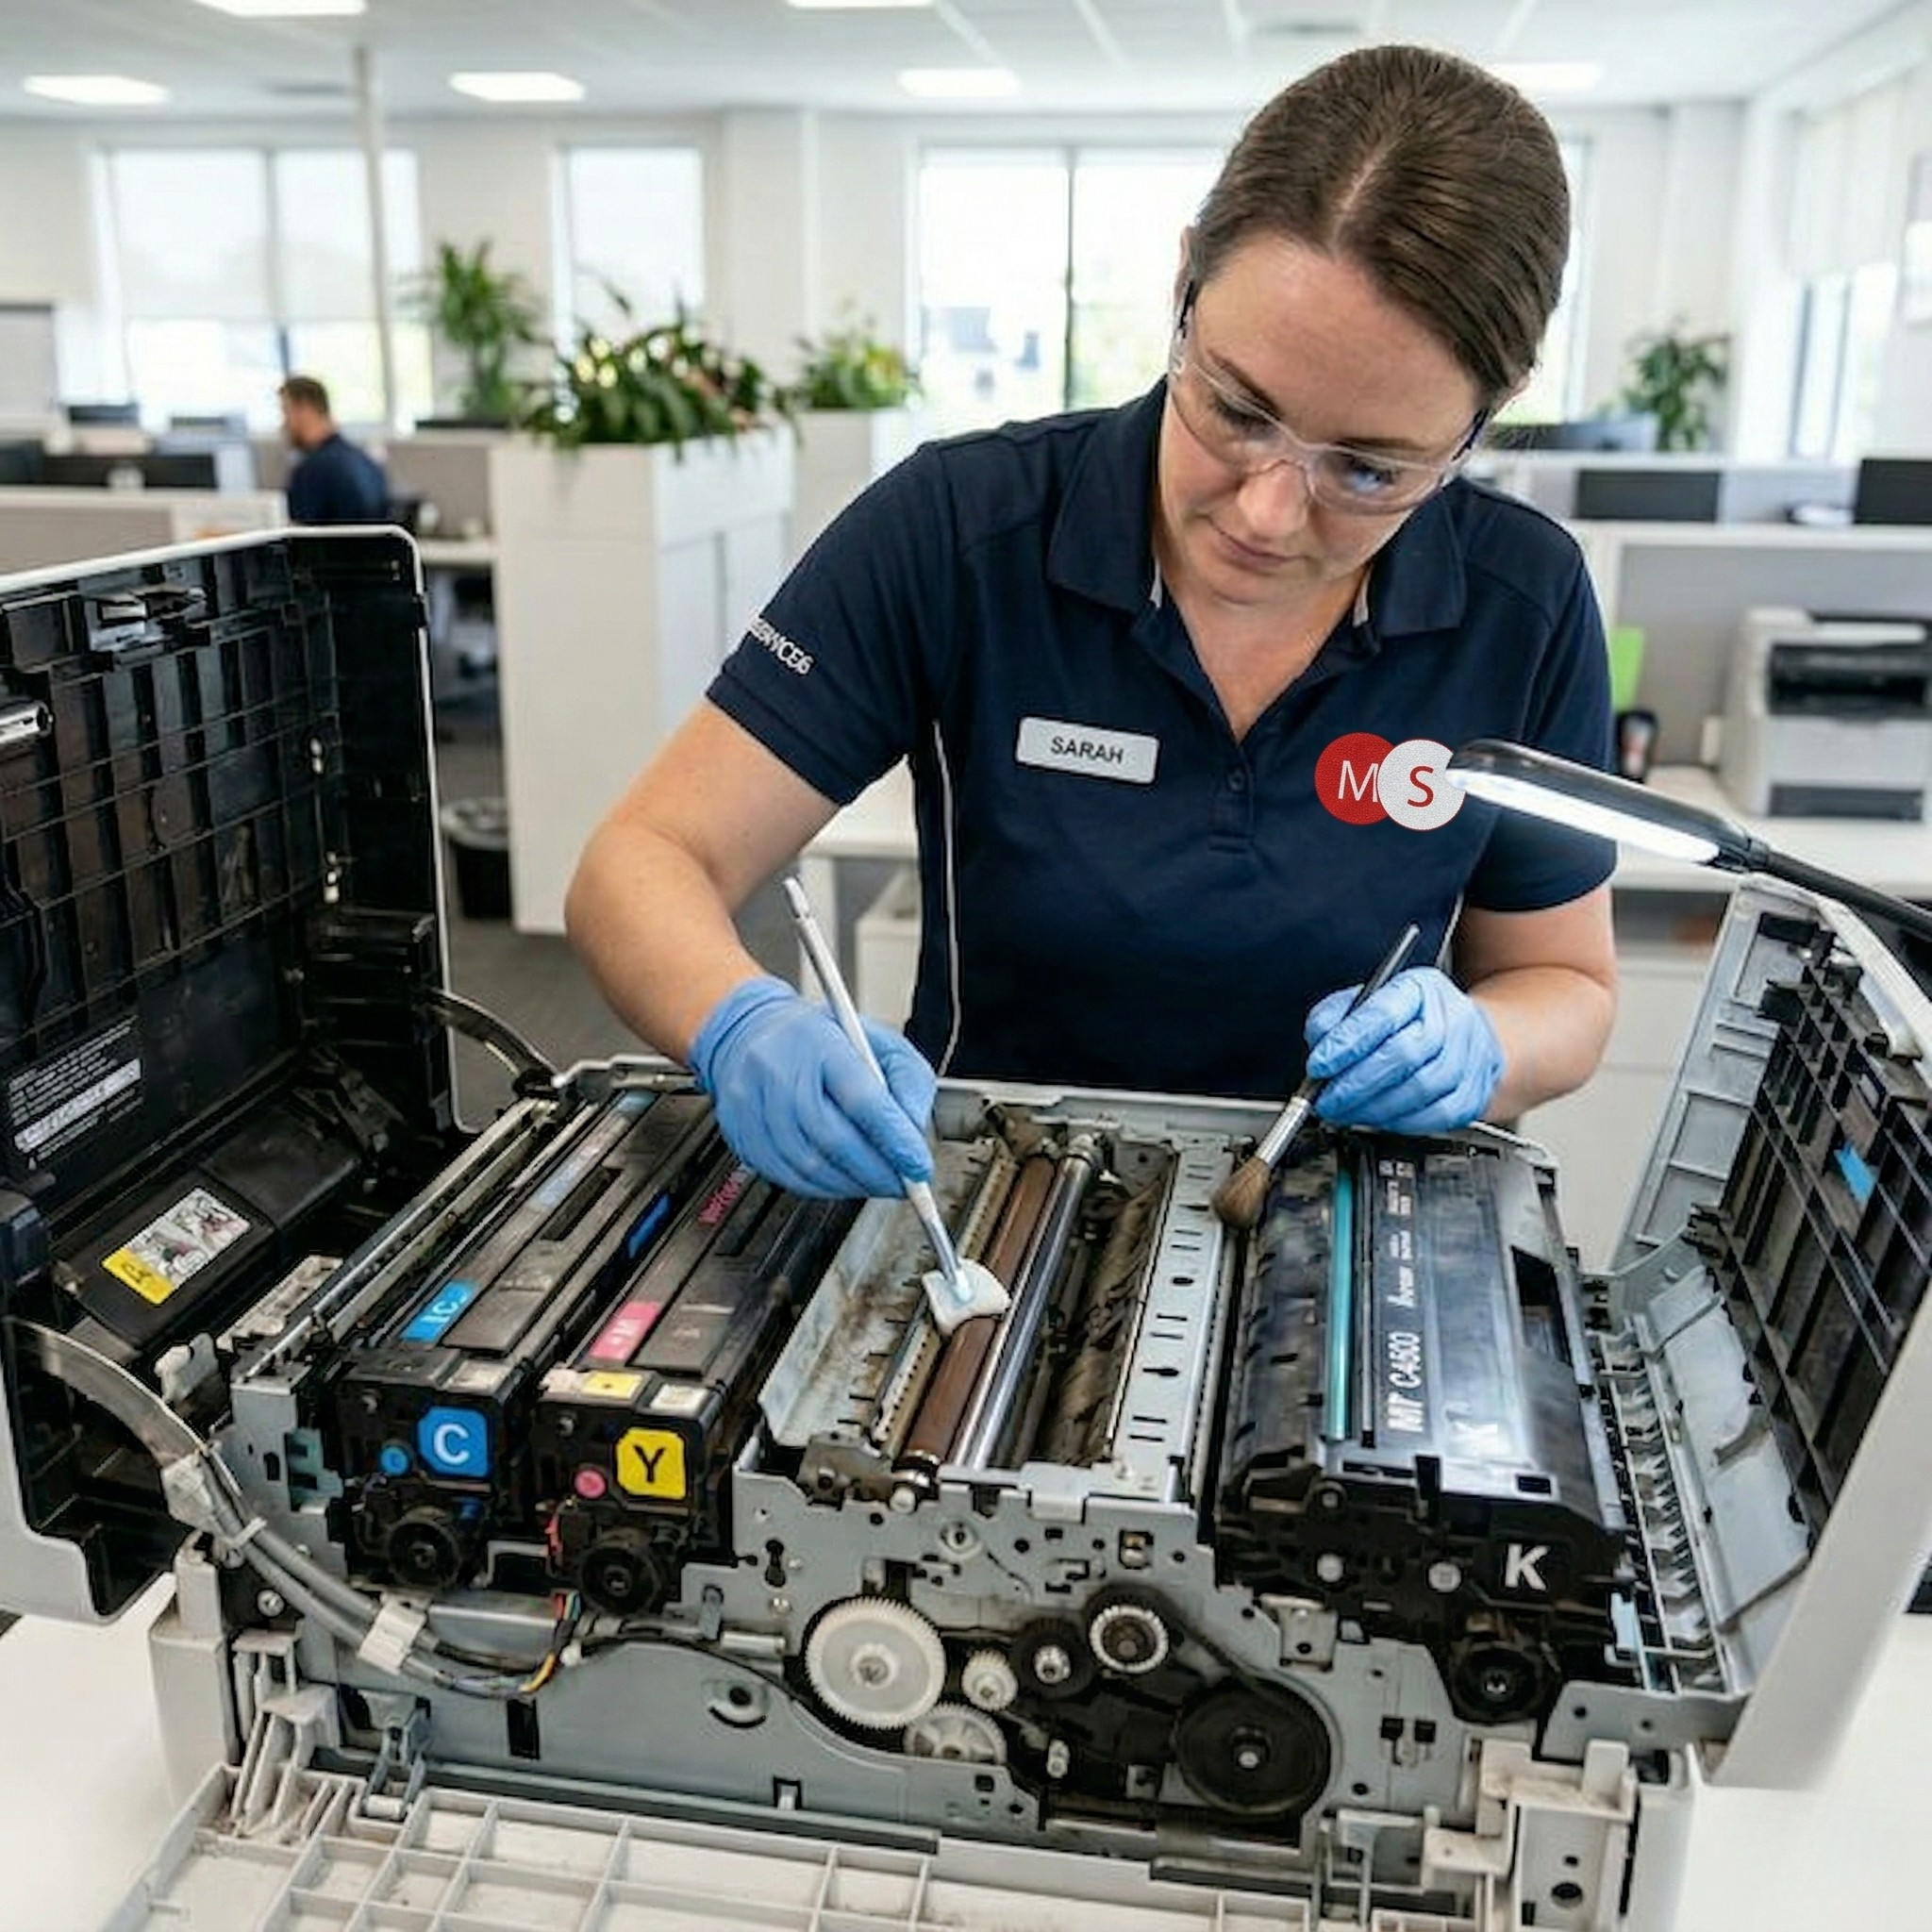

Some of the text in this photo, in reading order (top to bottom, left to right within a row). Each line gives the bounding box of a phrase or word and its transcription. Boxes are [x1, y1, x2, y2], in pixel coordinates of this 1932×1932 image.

[1050, 735, 1124, 764] SARAH
[433, 1423, 470, 1465] C
[632, 1444, 667, 1483] Y
[1504, 1542, 1551, 1592] K
